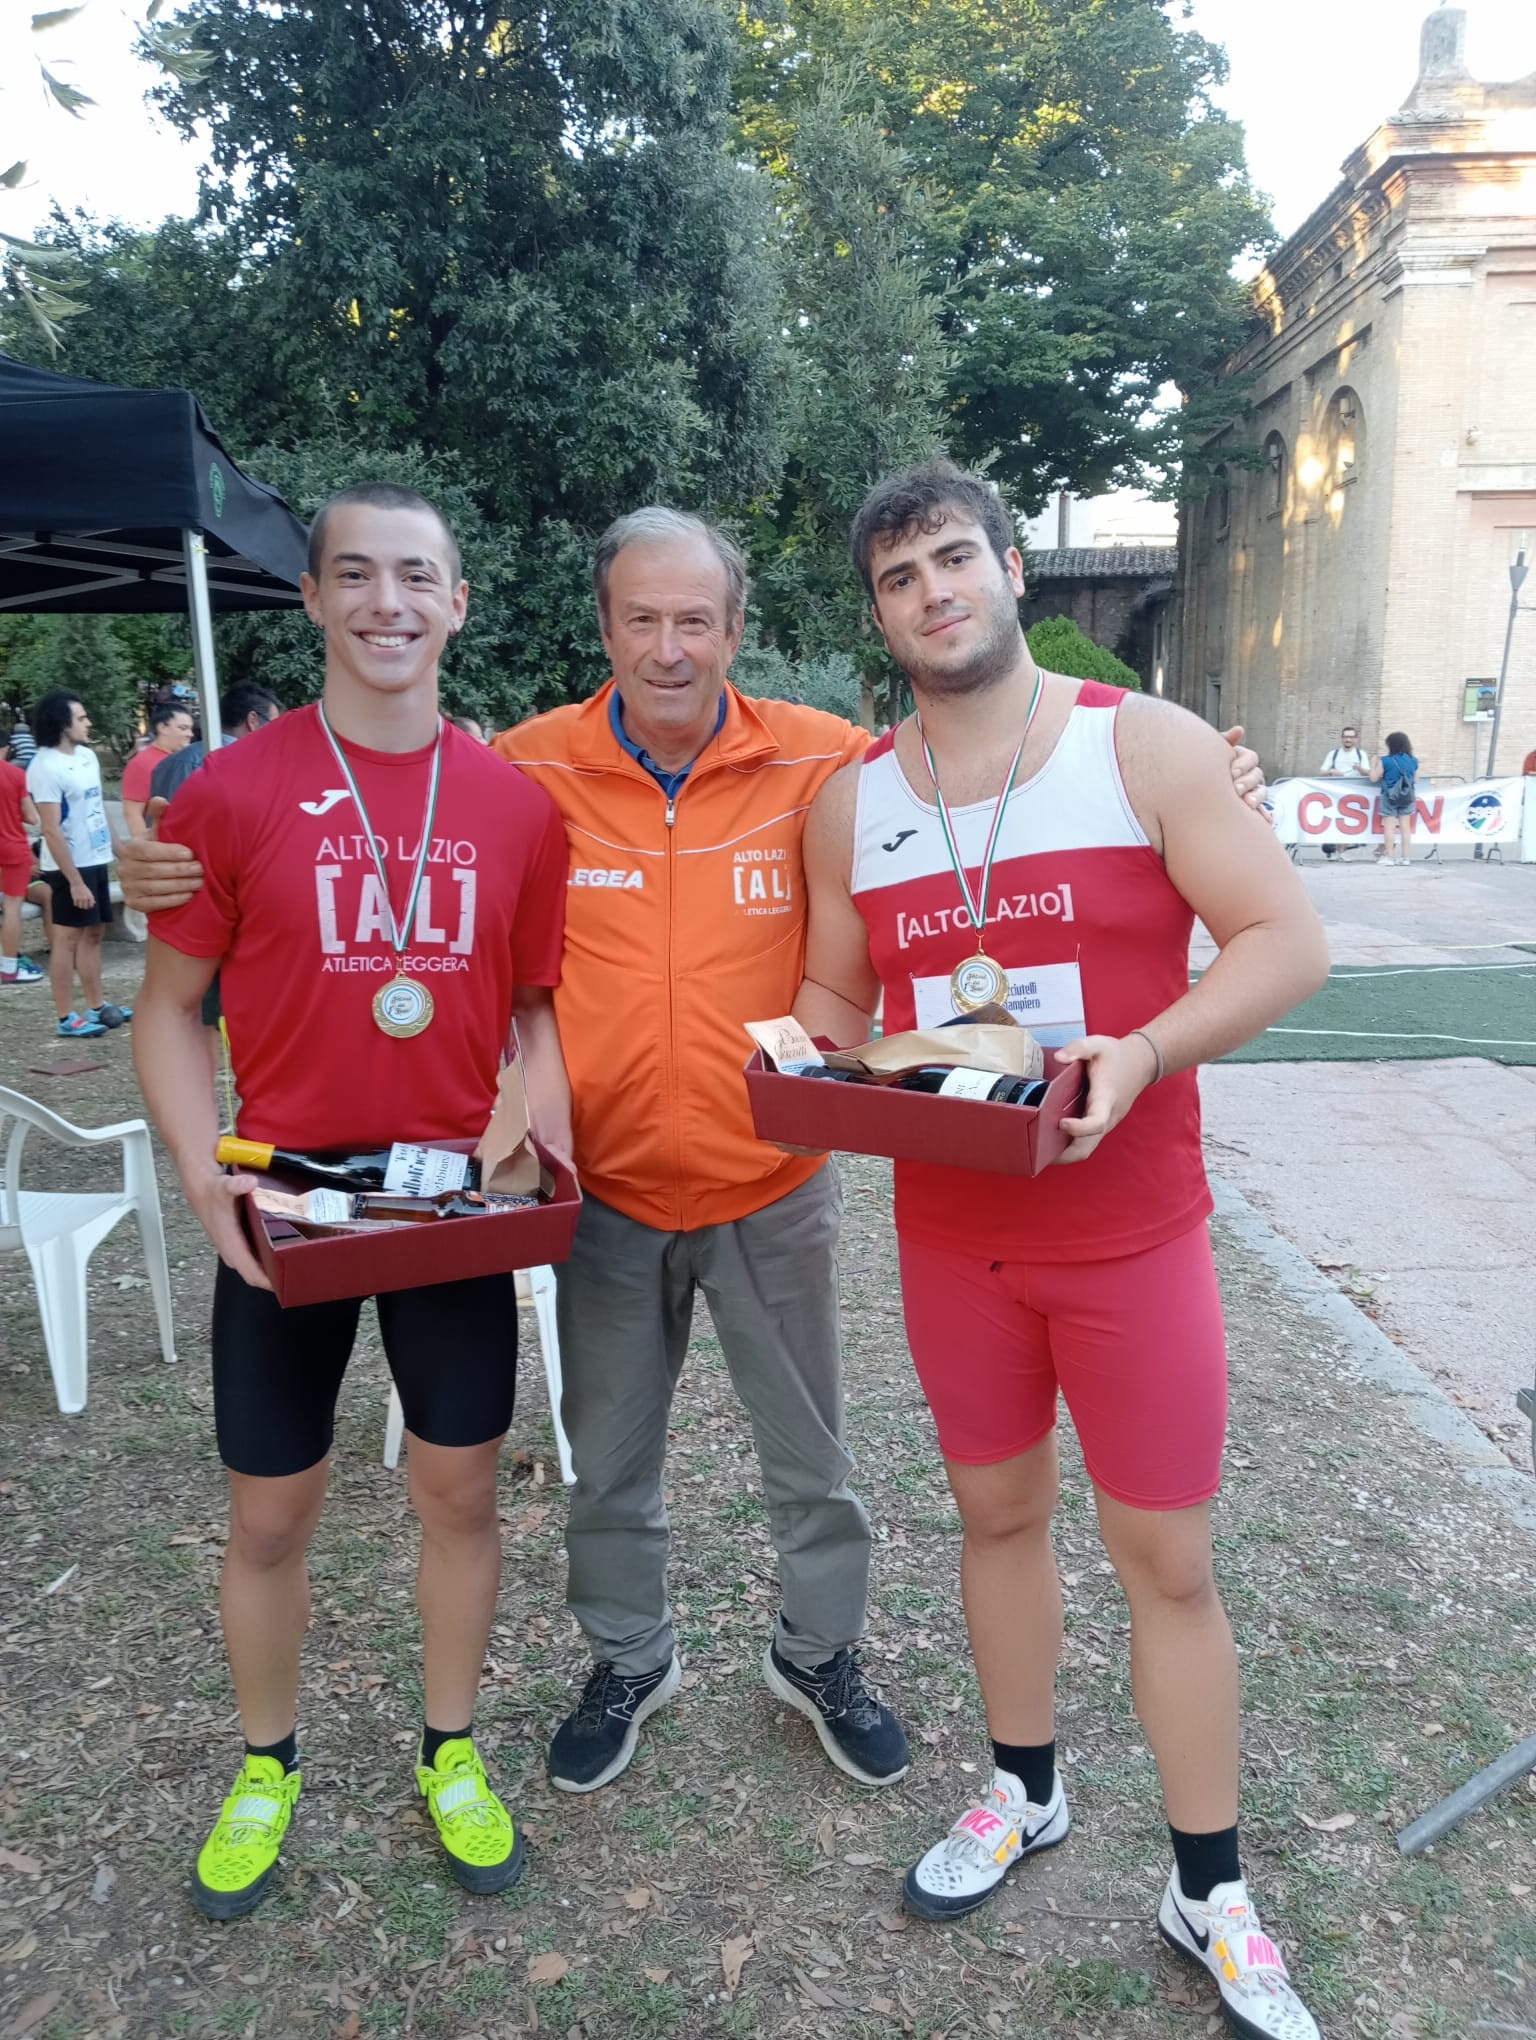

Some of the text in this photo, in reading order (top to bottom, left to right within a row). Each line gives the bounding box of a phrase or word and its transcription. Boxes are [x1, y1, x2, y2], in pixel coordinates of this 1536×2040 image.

[315, 835, 477, 865] ALTO LAZIO
[733, 849, 762, 863] ALTO
[567, 868, 643, 888] EGEA
[322, 956, 392, 972] ATLETICA
[1247, 1935, 1284, 1971] NIK
